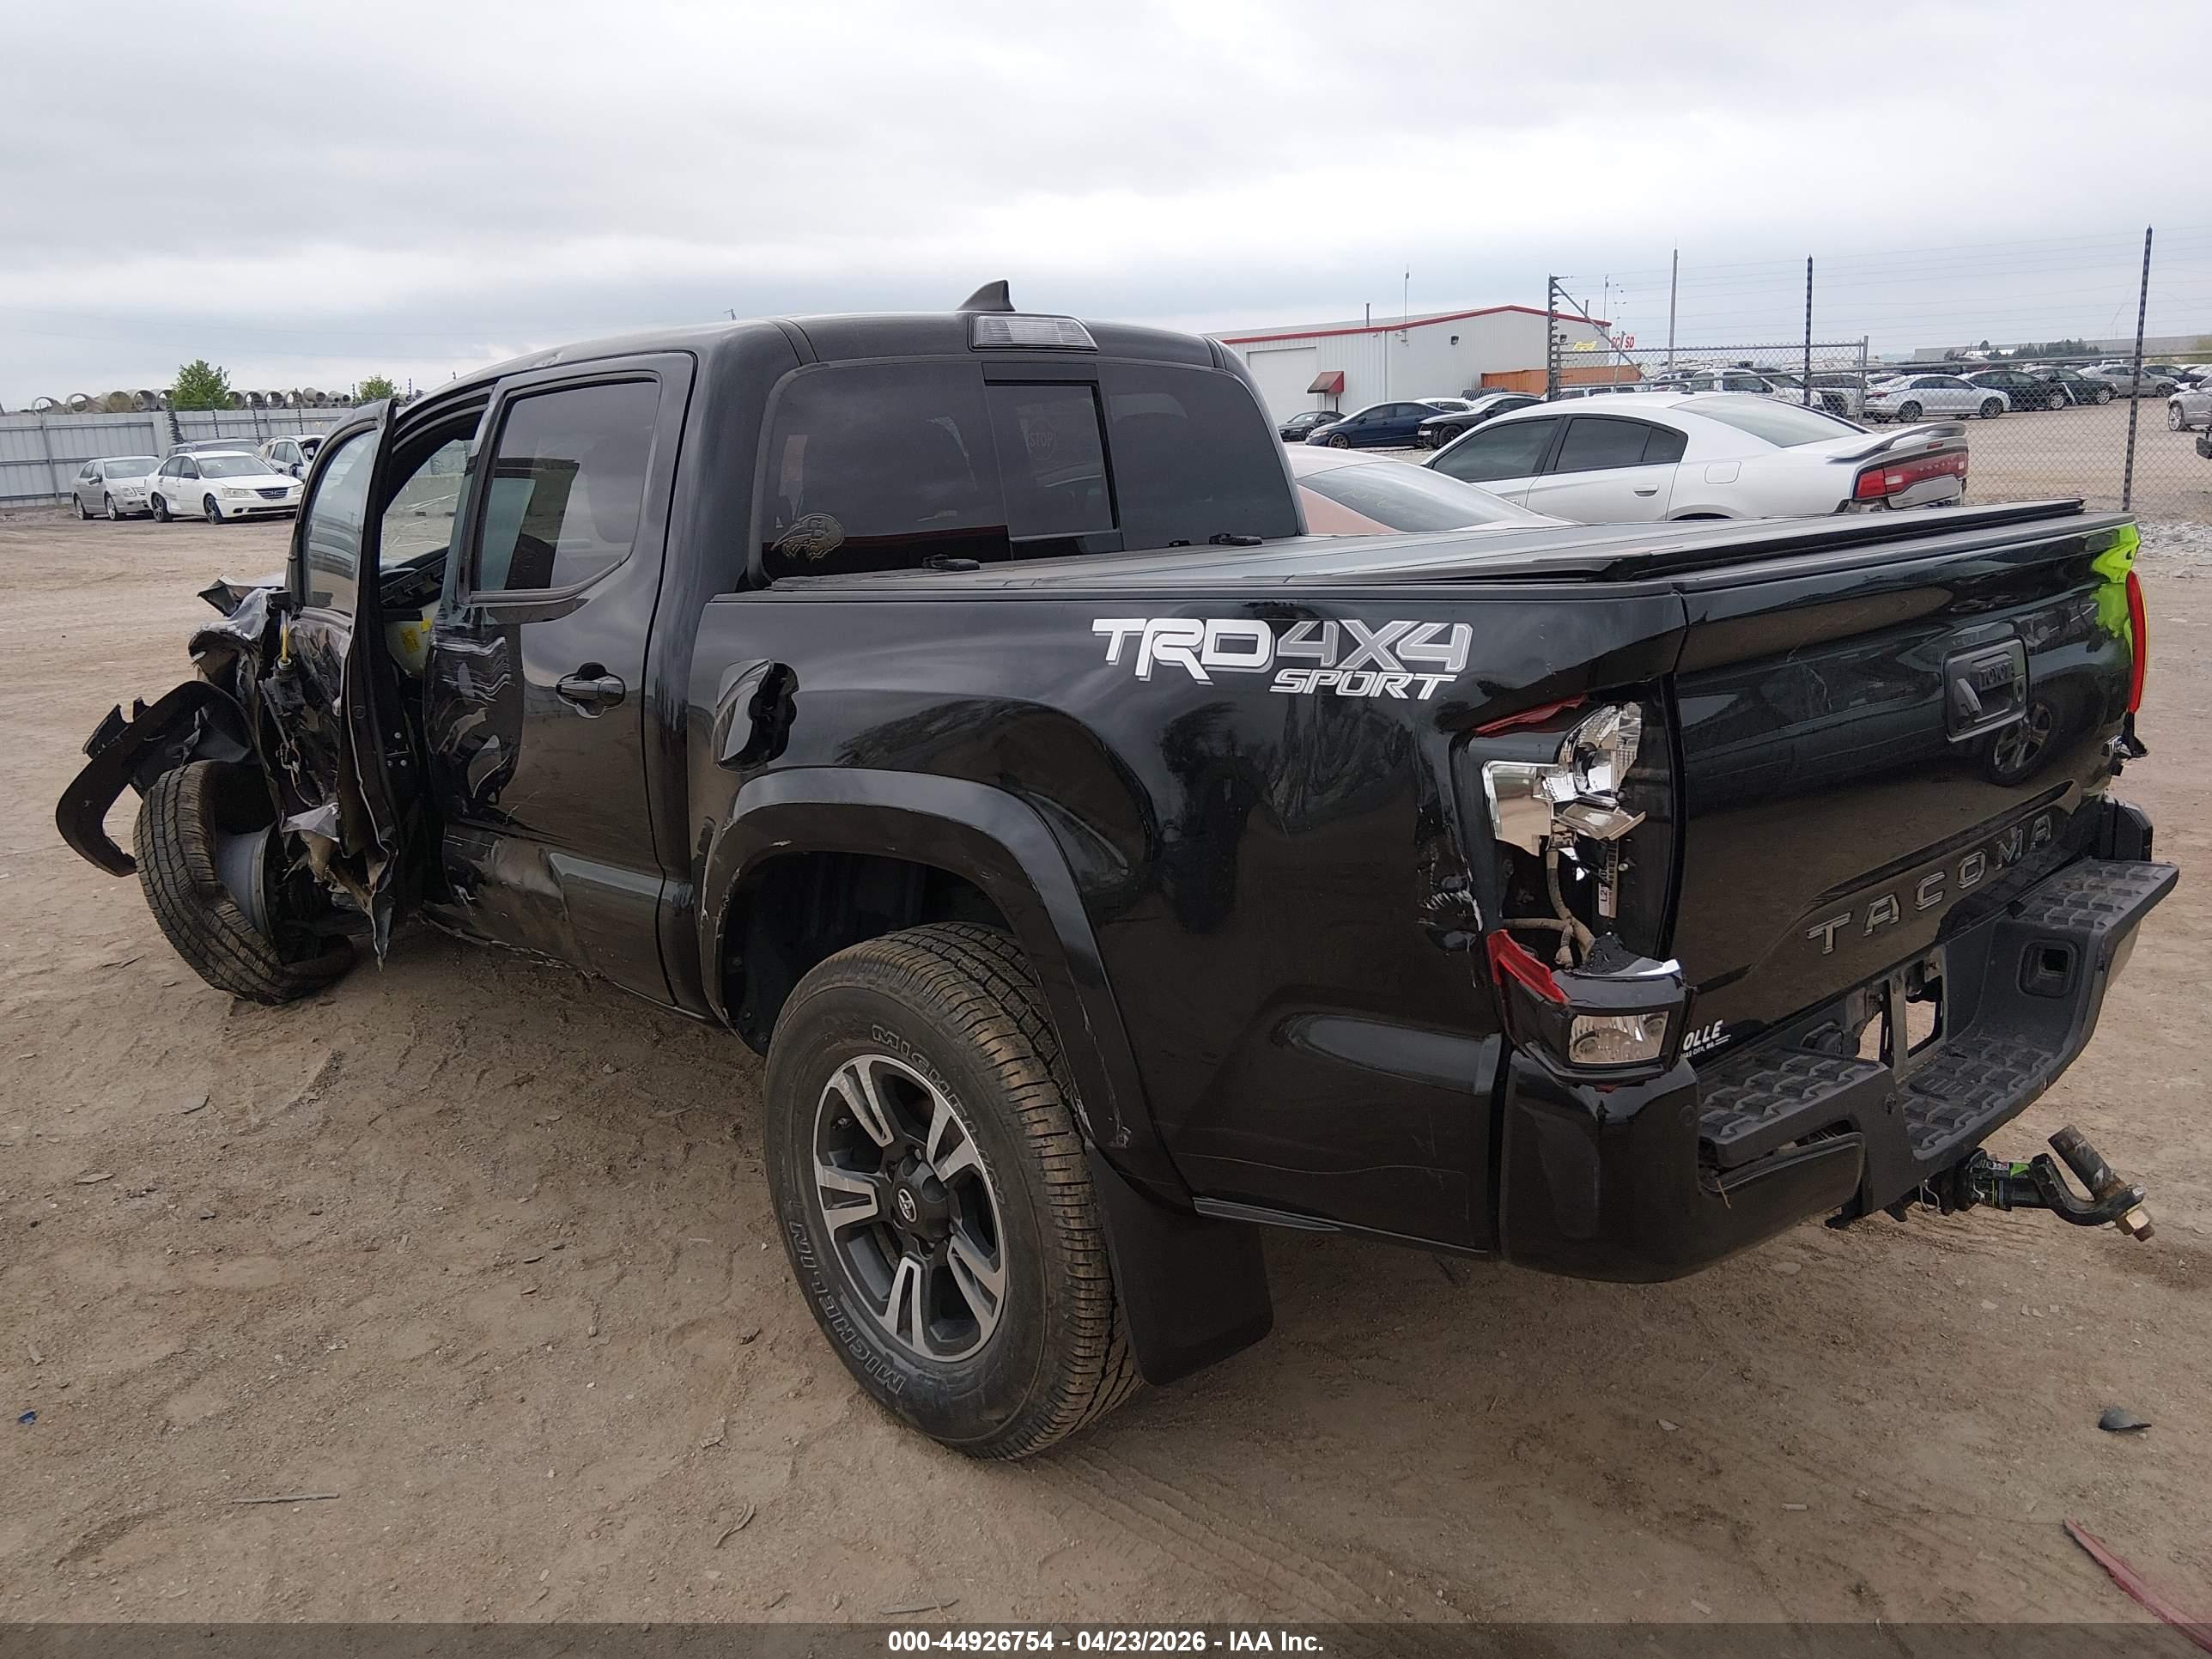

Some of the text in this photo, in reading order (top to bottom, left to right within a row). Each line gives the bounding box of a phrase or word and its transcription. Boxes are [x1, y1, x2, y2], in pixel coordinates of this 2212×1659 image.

[1030, 432, 1054, 447] STOP
[1092, 618, 1275, 685] TRD
[1269, 669, 1458, 700] SPORT
[1807, 815, 2052, 955] TACOMA
[1683, 1019, 1724, 1051] OLLE
[788, 1220, 908, 1395] MICHELIN
